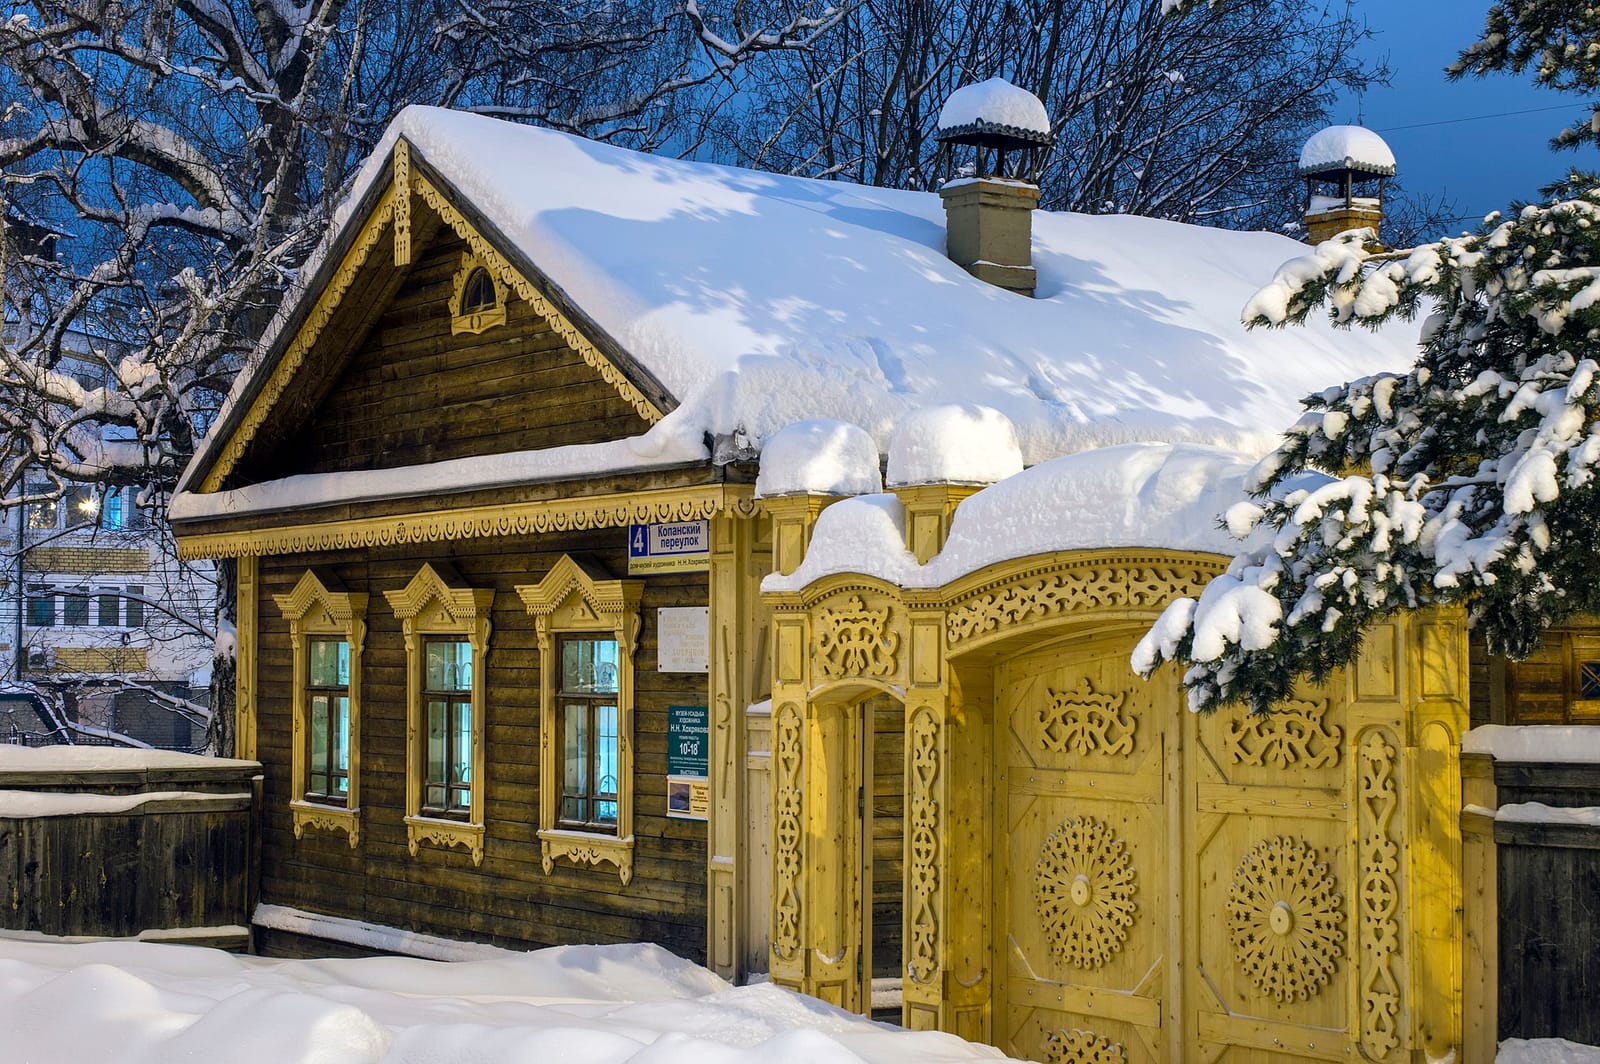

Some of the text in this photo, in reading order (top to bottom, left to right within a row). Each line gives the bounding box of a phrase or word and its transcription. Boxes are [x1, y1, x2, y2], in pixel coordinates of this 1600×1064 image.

[657, 523, 701, 538] Копанский
[633, 527, 644, 553] 4
[660, 536, 699, 550] переулок
